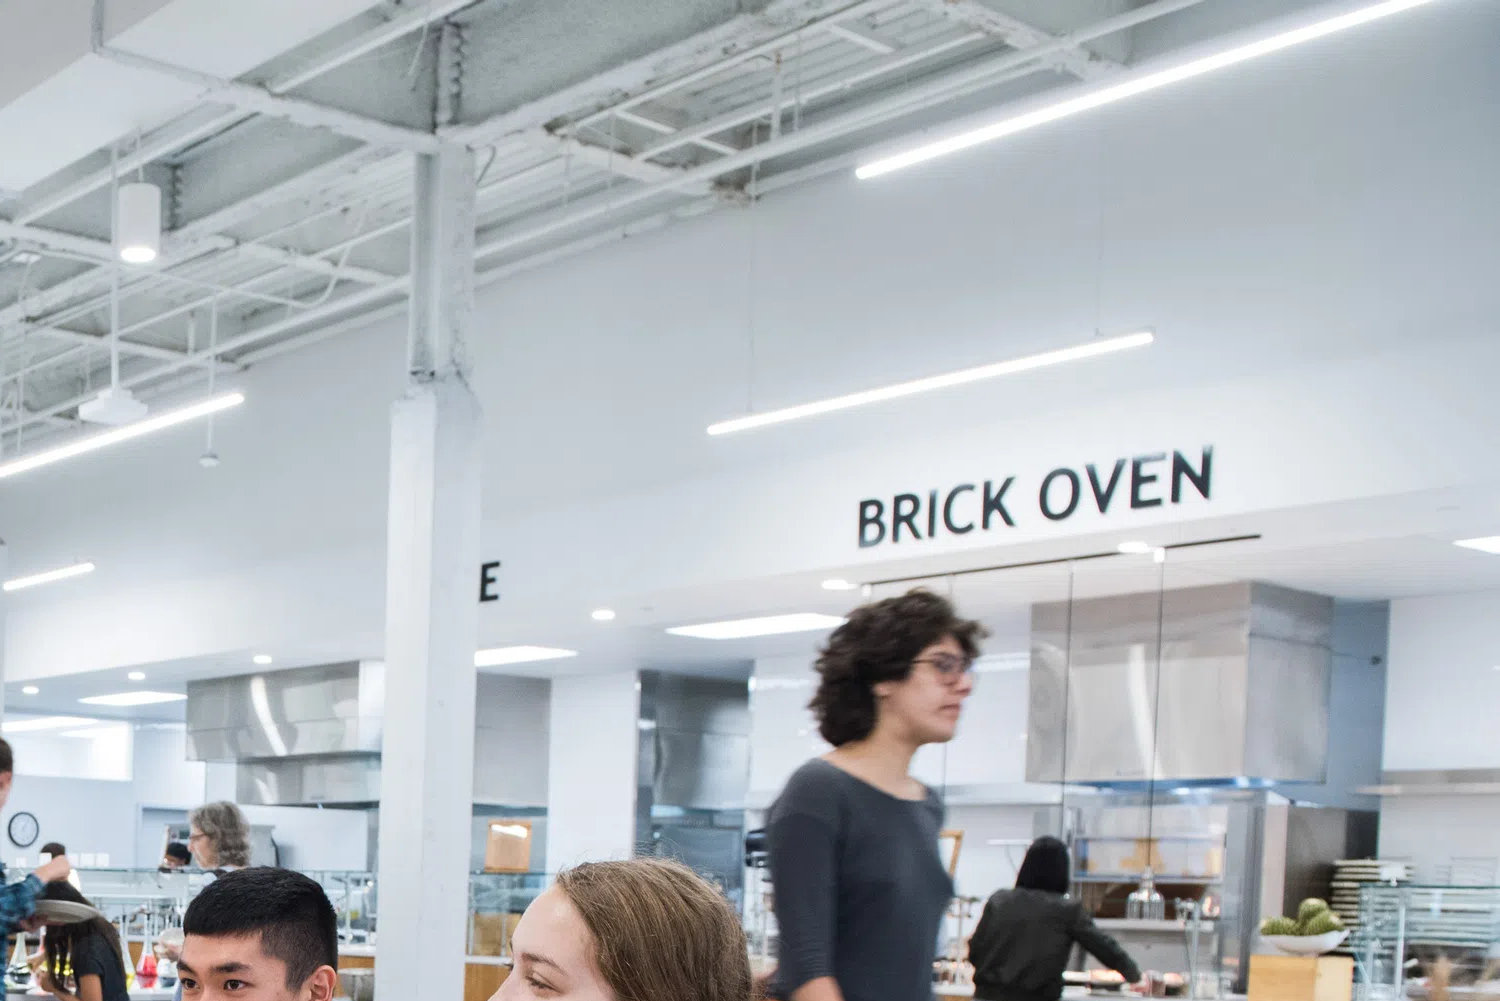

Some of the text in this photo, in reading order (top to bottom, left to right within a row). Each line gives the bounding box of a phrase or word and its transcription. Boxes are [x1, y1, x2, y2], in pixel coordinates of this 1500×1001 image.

[859, 444, 1213, 548] BRICK OVEN
[479, 561, 501, 603] E
